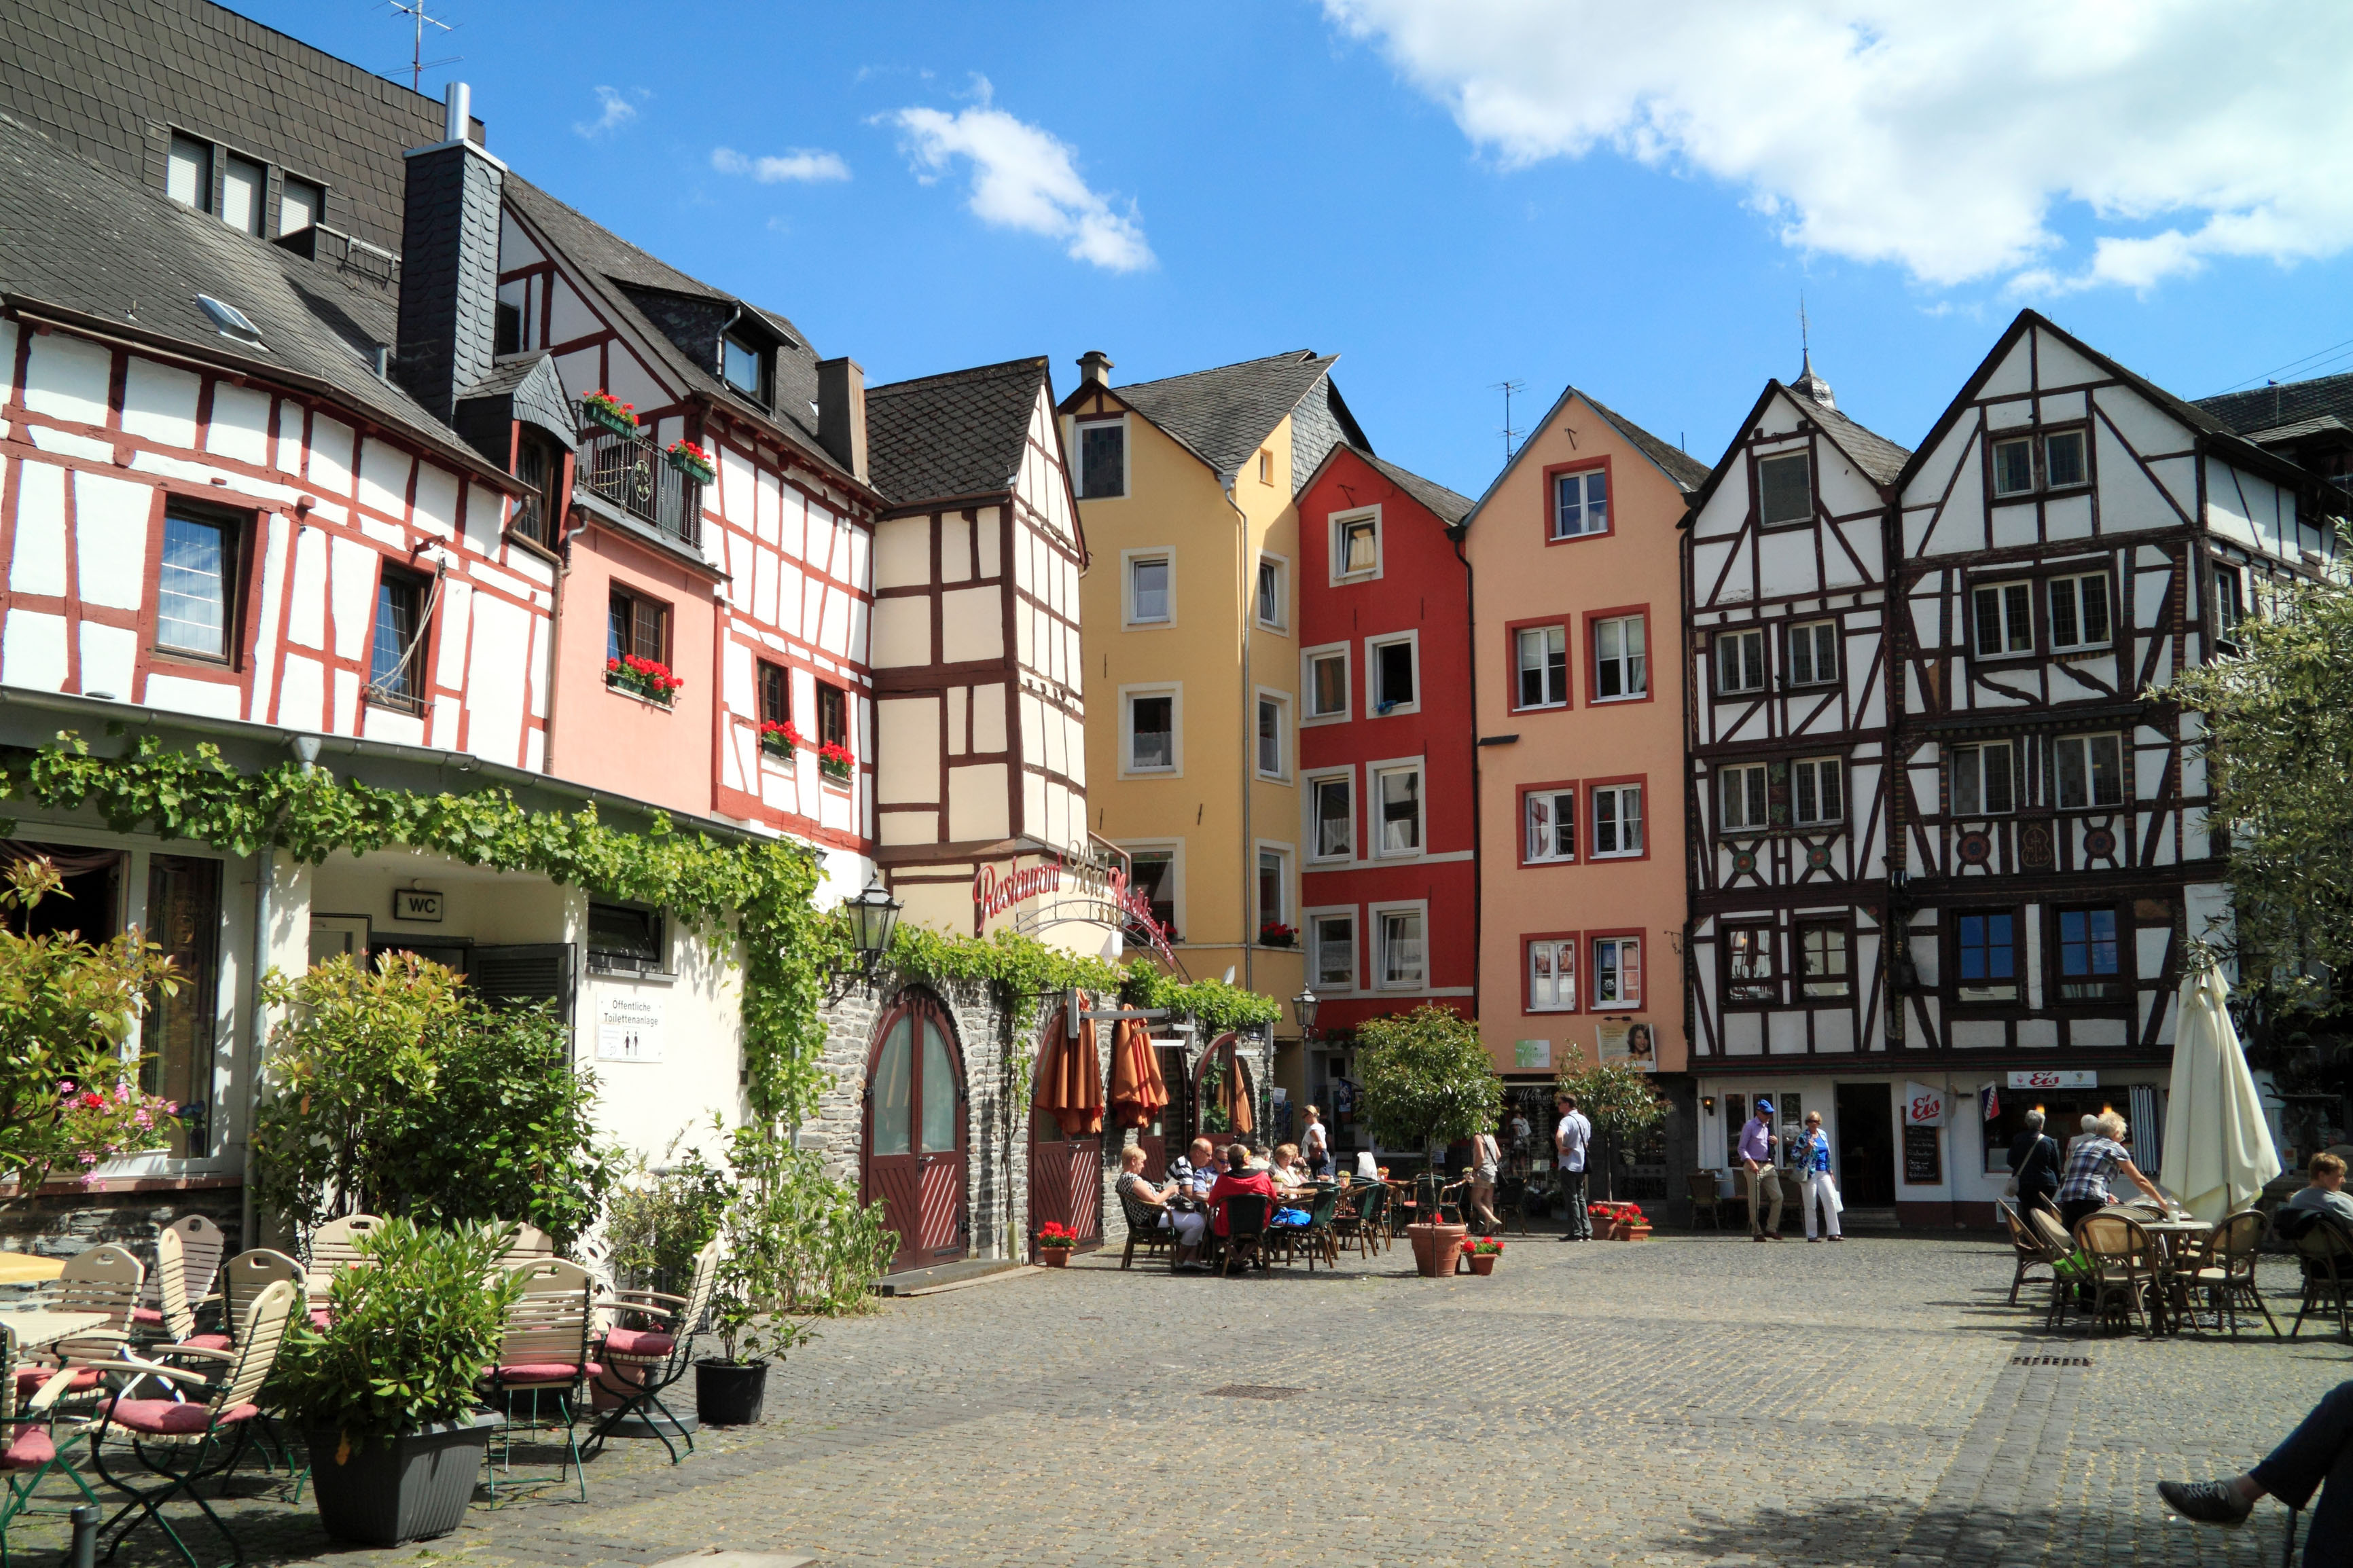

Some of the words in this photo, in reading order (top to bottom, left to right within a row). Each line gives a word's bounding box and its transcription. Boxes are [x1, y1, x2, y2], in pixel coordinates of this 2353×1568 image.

[973, 851, 1062, 932] Restaurant
[1066, 839, 1109, 898] Hotel
[409, 898, 435, 913] WC
[613, 998, 651, 1011] Öffentliche
[604, 1013, 658, 1027] Toilettenanlage
[2030, 1072, 2060, 1087] Eis
[1517, 1088, 1553, 1101] Weinart
[1911, 1094, 1940, 1121] Eis
